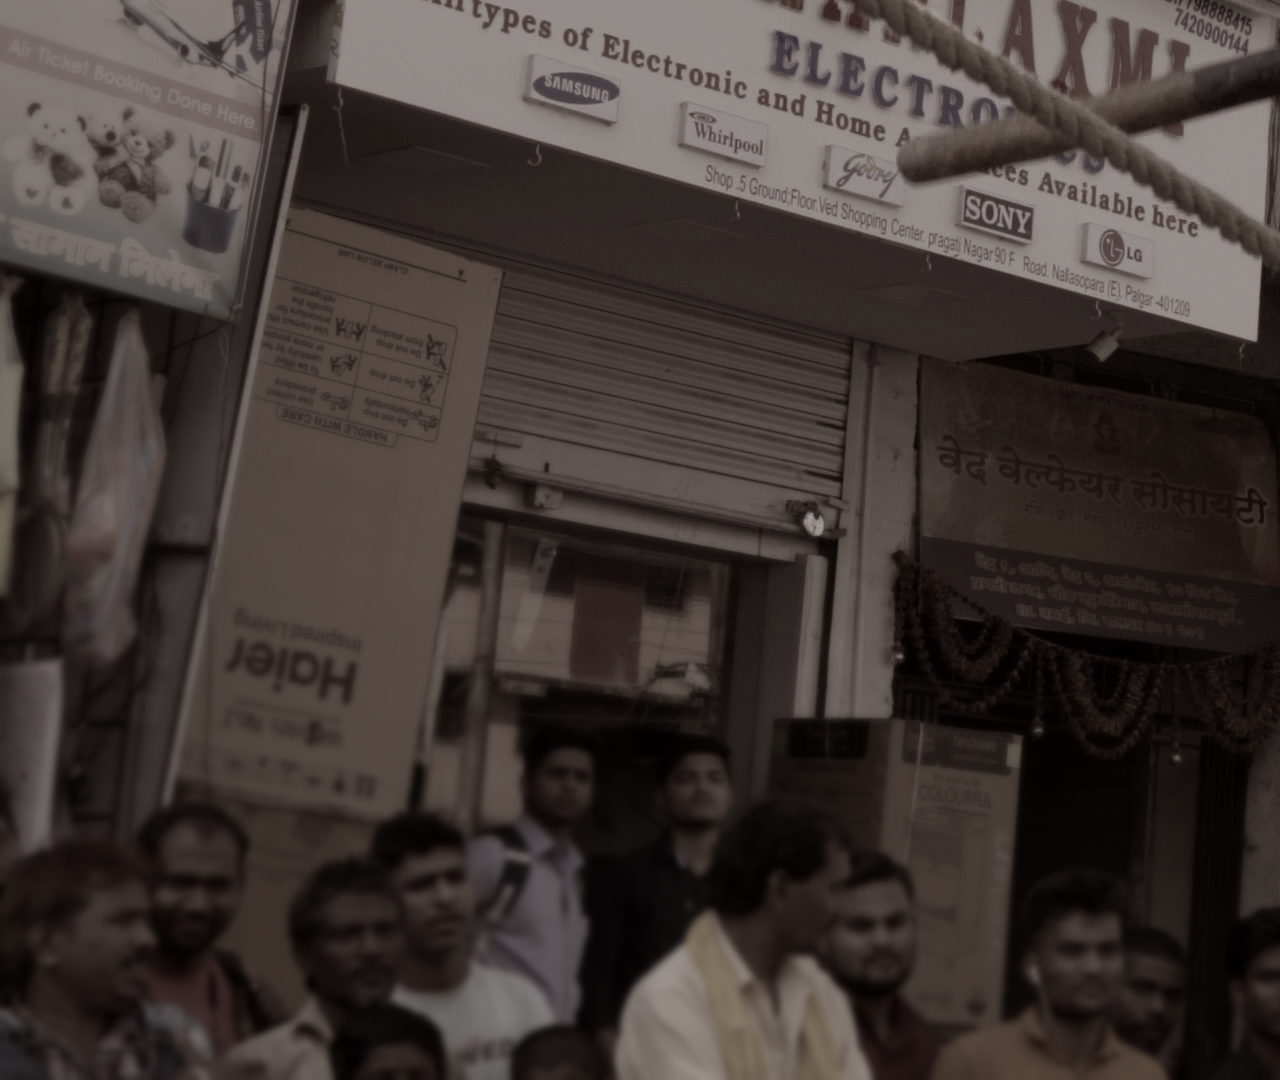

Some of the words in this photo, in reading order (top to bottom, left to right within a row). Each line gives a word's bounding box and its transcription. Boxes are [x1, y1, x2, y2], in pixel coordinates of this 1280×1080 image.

[8, 37, 32, 57] Air
[37, 42, 90, 78] Ticket
[94, 64, 162, 105] Booking
[166, 86, 212, 116] Done
[217, 101, 259, 133] Here.
[543, 73, 609, 103] SAMSUNG
[563, 28, 593, 57] of
[601, 34, 748, 101] Electronic
[757, 86, 806, 118] and
[815, 100, 887, 143] Home
[1037, 171, 1146, 222] Available
[1152, 205, 1200, 238] here
[694, 122, 764, 156] Whirlpool
[705, 165, 733, 190] Shop
[841, 202, 887, 235] Shopping
[964, 195, 1032, 234] SONY
[281, 407, 312, 423] CARE
[314, 415, 342, 432] WITH
[344, 424, 389, 443] HANDLE
[937, 434, 988, 486] वेद
[1130, 471, 1270, 525] सोसायटी
[233, 607, 287, 640] Living
[290, 625, 361, 656] Inspired
[225, 638, 358, 707] Haier
[953, 733, 997, 752] hindware
[919, 784, 993, 808] COLOURFUL
